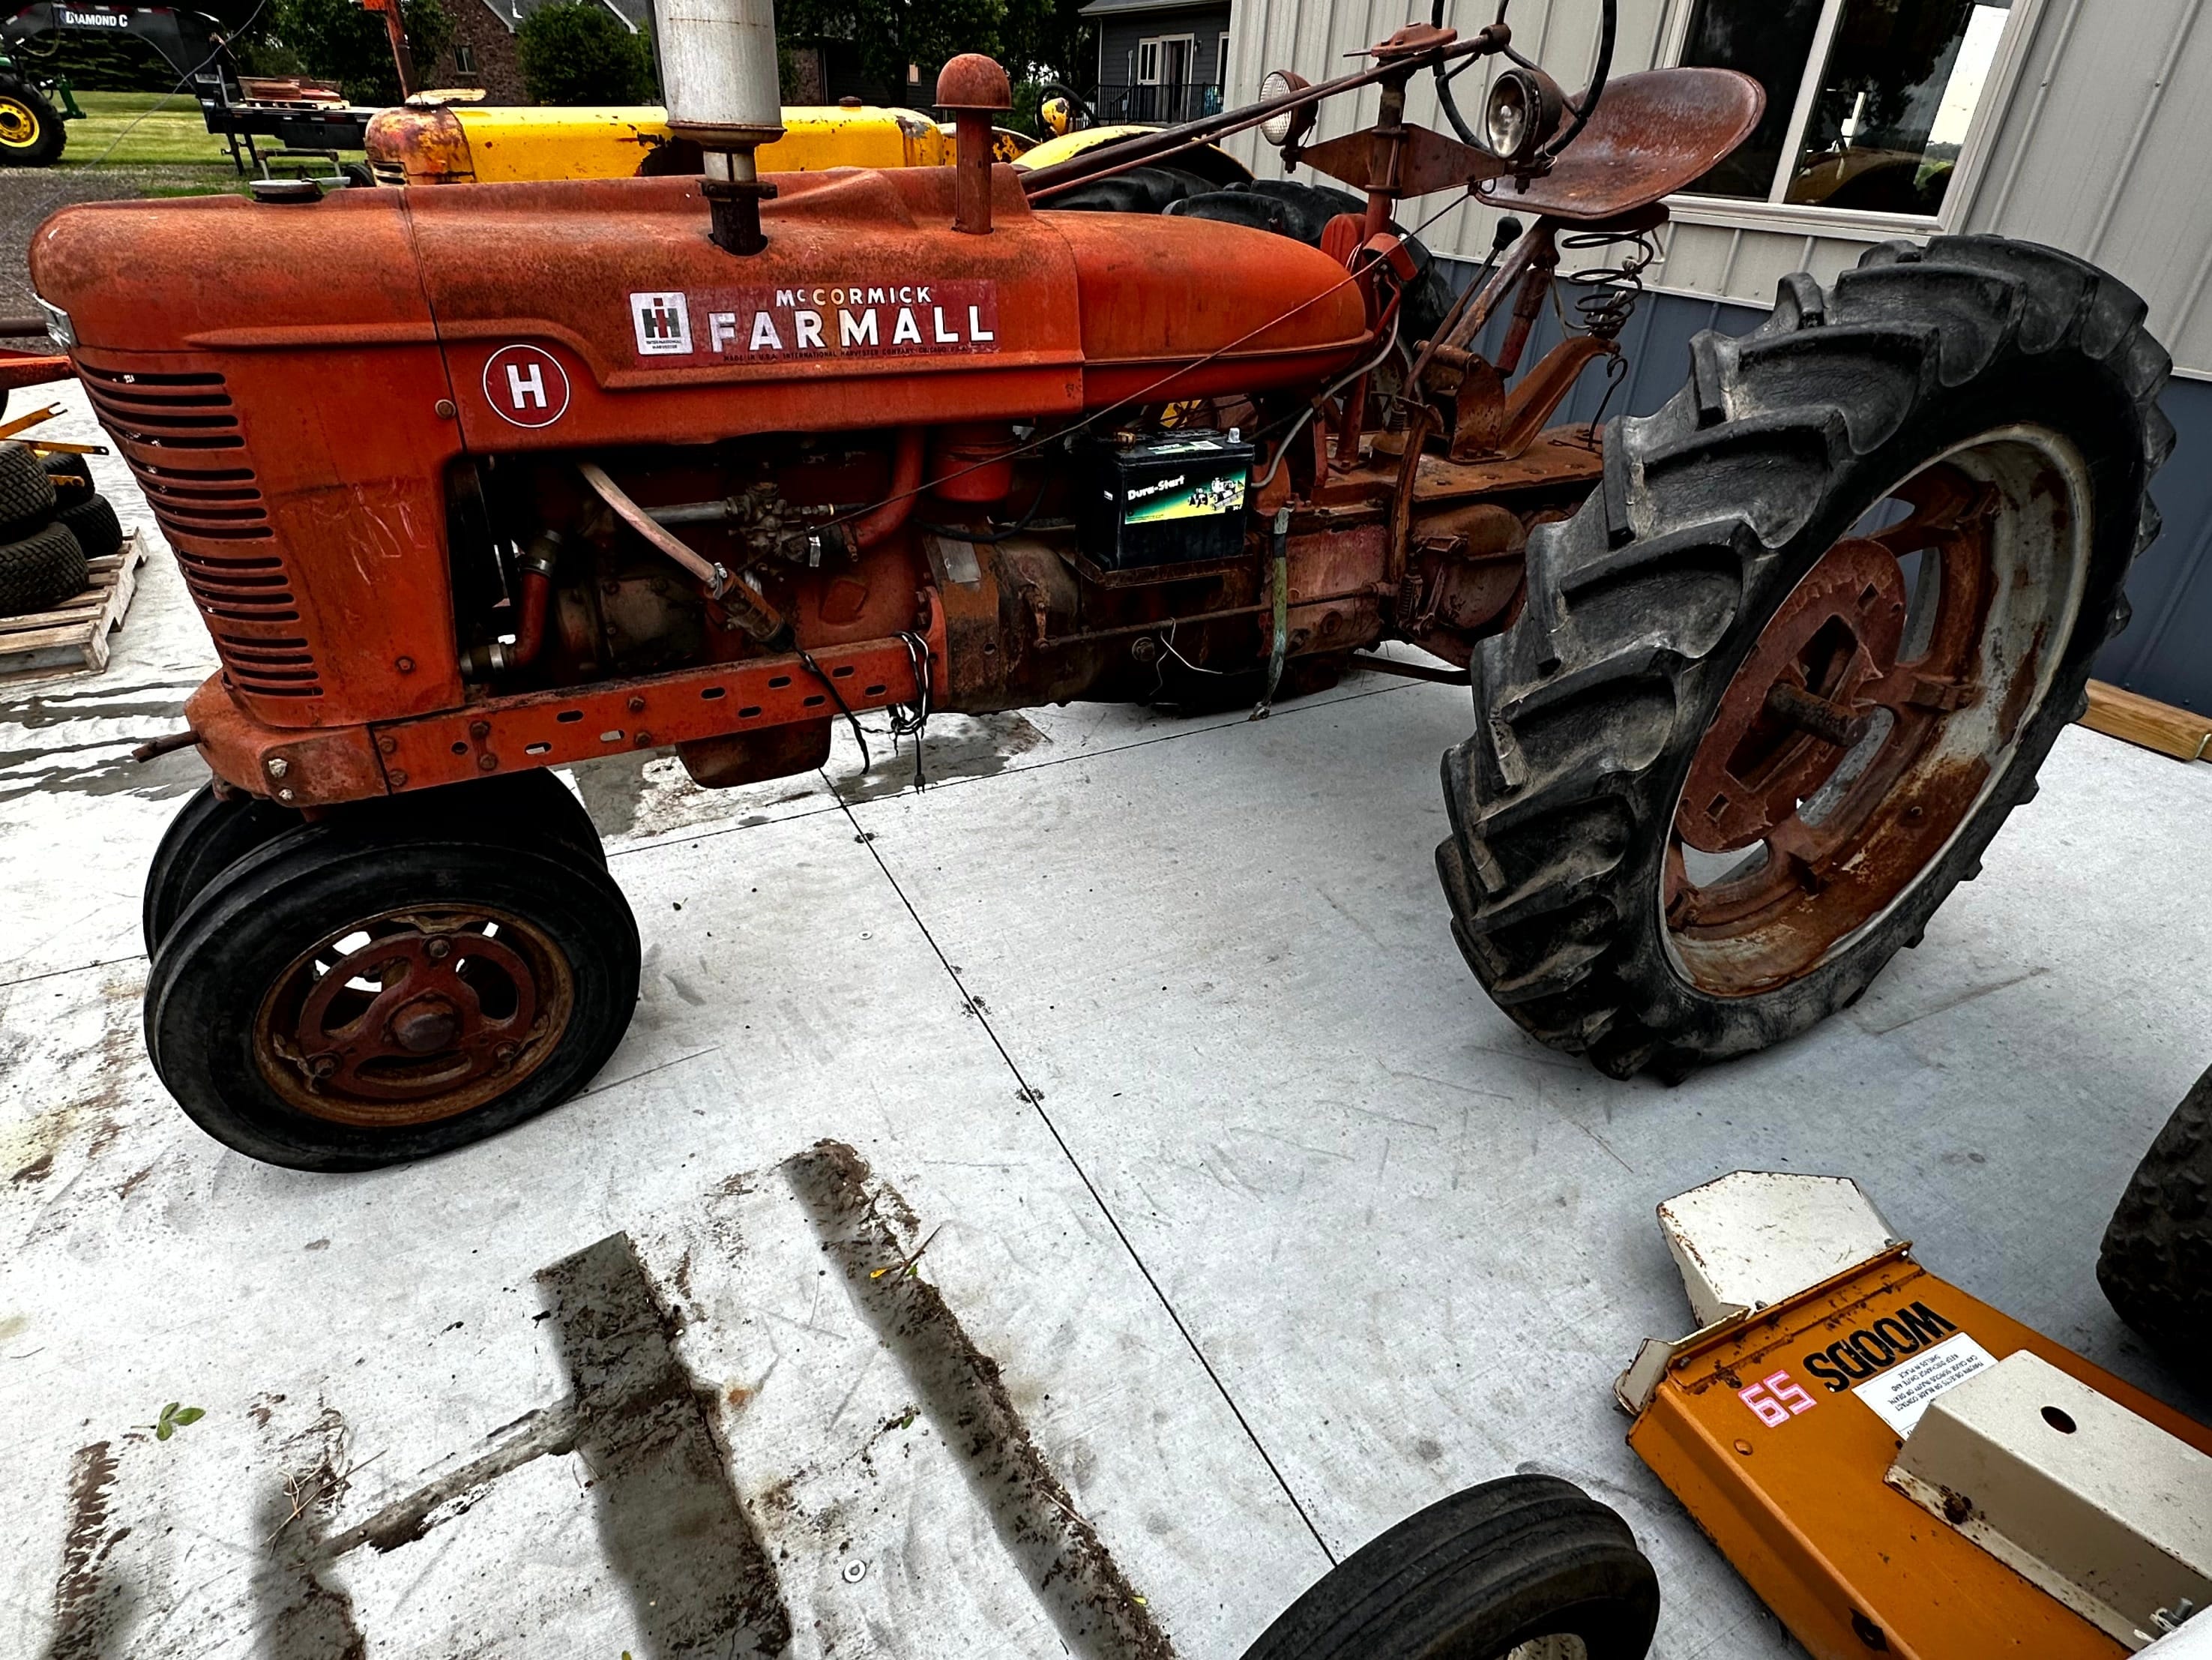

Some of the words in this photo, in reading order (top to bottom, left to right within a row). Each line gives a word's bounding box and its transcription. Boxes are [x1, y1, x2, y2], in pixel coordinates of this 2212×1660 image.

[65, 10, 117, 26] DIAMOND
[119, 14, 128, 27] C
[708, 305, 995, 352] FARMALL
[783, 351, 837, 359] INTERNATIONAL
[506, 364, 547, 409] H
[1127, 475, 1184, 501] Dura-Start
[1803, 1301, 1957, 1392] WOODS
[1738, 1370, 1817, 1428] 59
